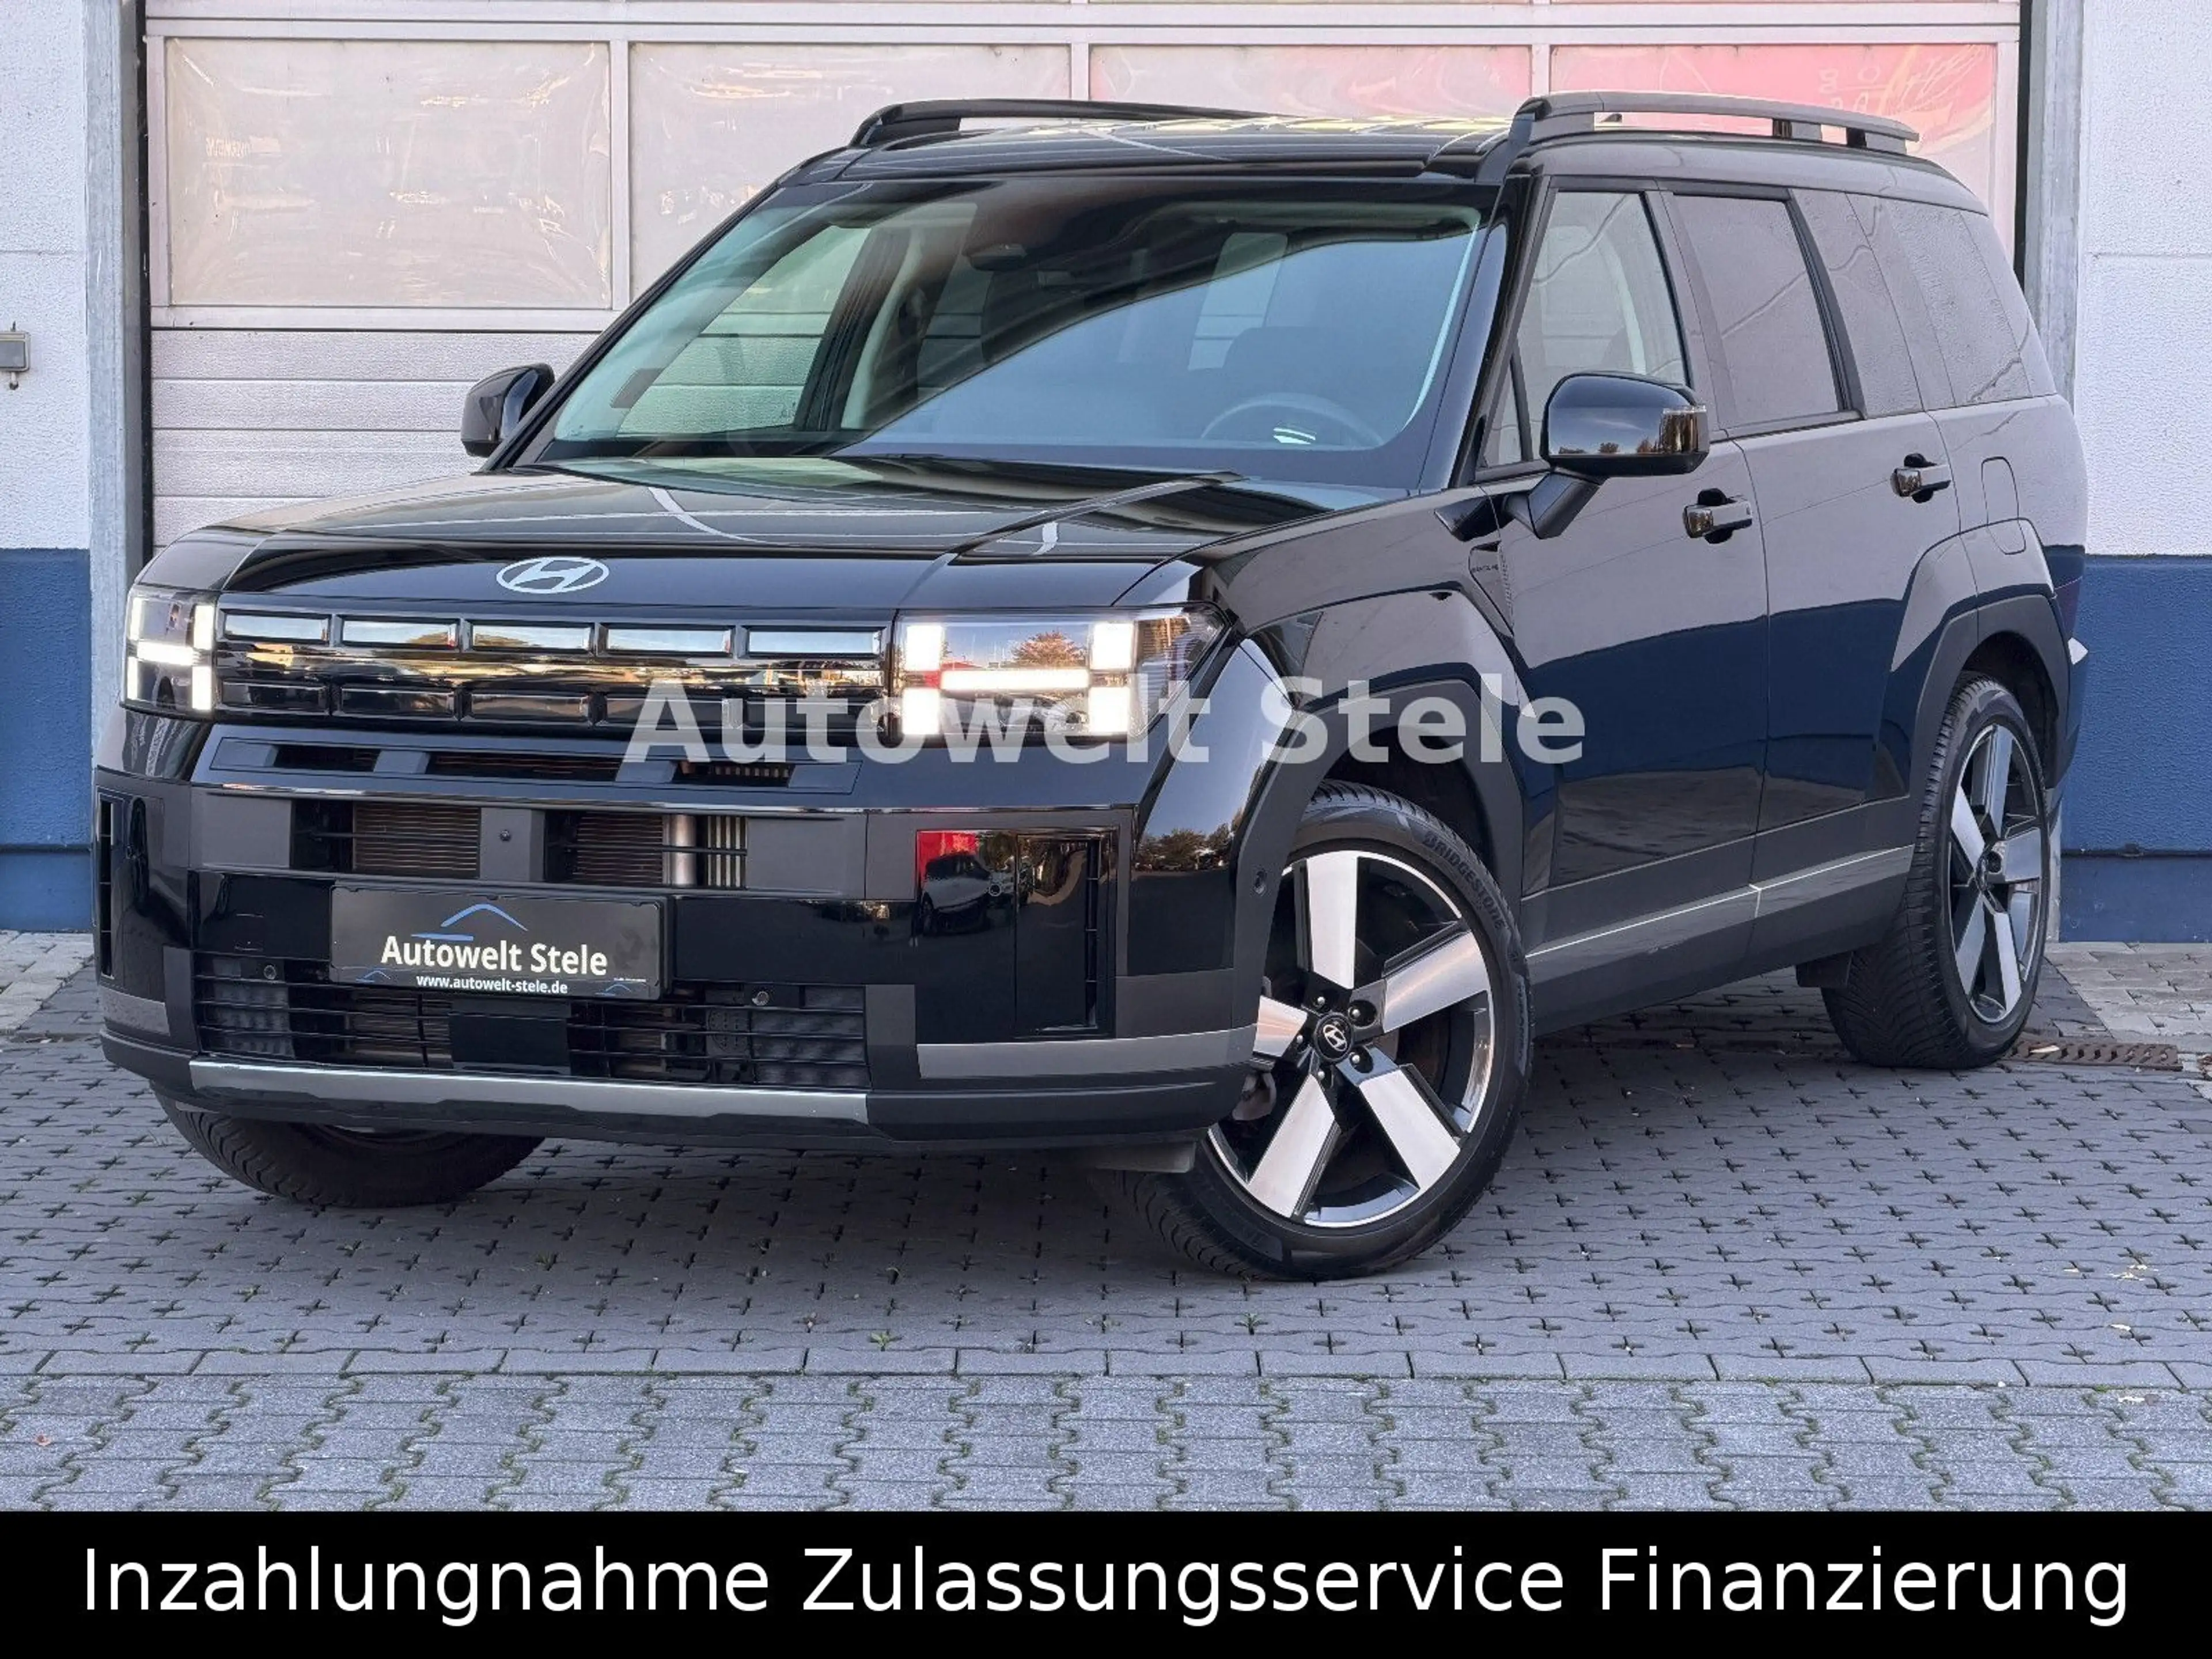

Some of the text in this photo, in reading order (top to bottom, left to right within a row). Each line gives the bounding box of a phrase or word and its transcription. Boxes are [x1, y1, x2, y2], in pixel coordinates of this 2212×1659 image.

[380, 935, 608, 976] Autowelt Stele
[416, 974, 569, 994] www.autowelt-stele.de
